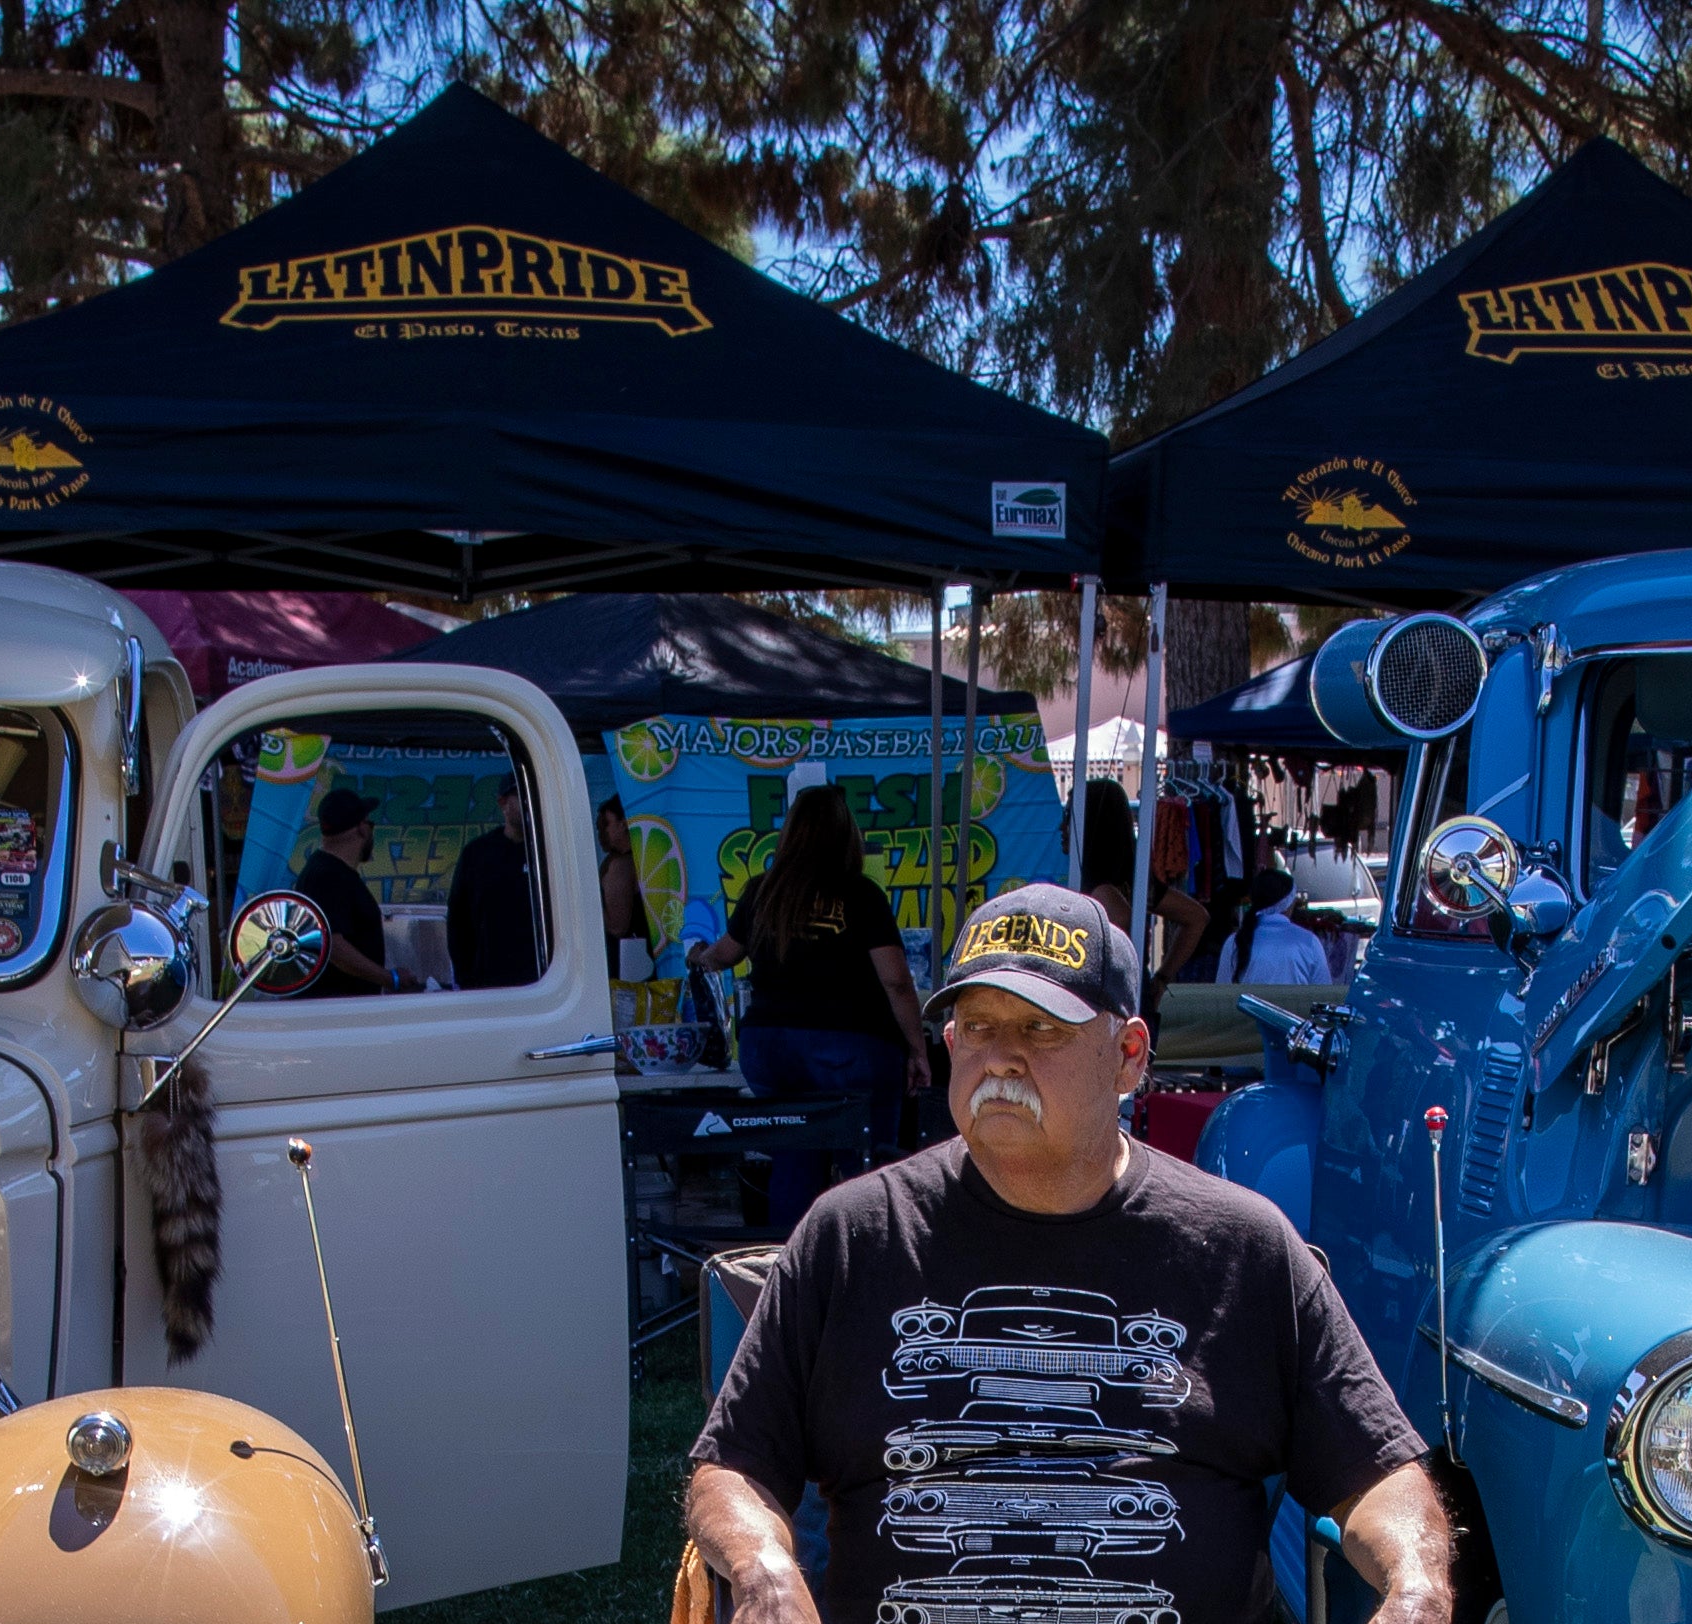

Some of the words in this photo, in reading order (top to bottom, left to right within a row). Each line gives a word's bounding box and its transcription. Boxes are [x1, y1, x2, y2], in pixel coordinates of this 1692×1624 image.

[354, 321, 391, 339] El
[494, 321, 581, 340] Texas
[1595, 363, 1628, 379] El
[18, 394, 36, 408] de
[39, 397, 54, 414] El
[1352, 456, 1369, 470] de
[1371, 460, 1385, 476] El
[32, 470, 56, 487] Park
[9, 495, 42, 511] Park
[44, 492, 61, 507] El
[60, 472, 91, 498] Paso
[995, 503, 1058, 525] Eurmax
[1319, 529, 1356, 549] Lincoln
[1358, 530, 1381, 547] Park
[1286, 531, 1331, 564] Chicano
[1335, 553, 1365, 568] Park
[1368, 550, 1383, 565] El
[1382, 533, 1412, 558] Paso
[649, 722, 803, 758] MAJORS
[808, 725, 972, 759] BASEBALL
[746, 773, 965, 831] FESH
[959, 914, 1089, 970] LEGENDS
[732, 1117, 772, 1127] OZARK
[773, 1115, 806, 1126] TRAIL
